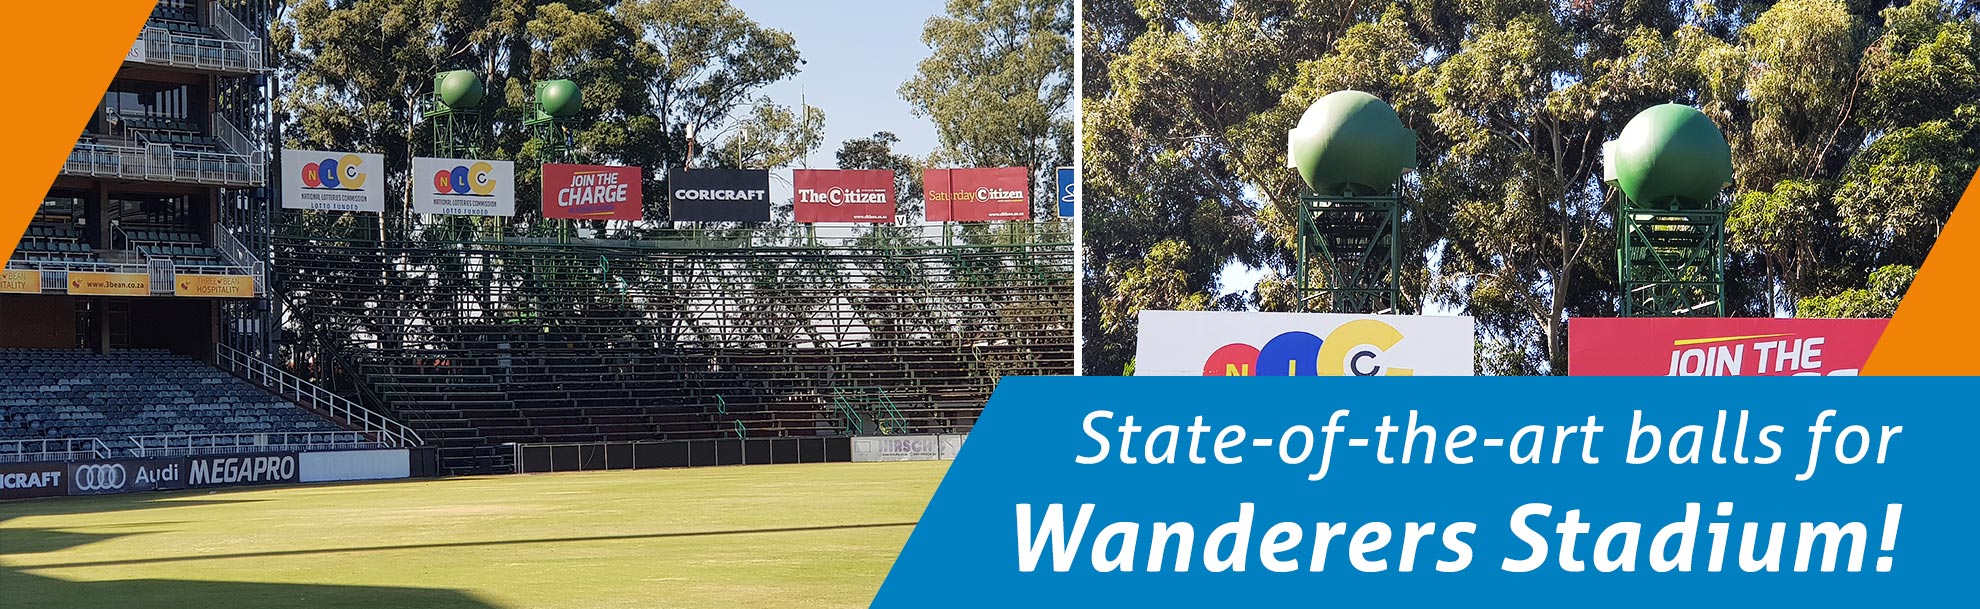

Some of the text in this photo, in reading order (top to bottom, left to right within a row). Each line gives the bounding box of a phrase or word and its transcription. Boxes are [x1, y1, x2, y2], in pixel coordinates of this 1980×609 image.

[570, 172, 619, 187] JOIN THE
[301, 193, 367, 203] NATIONAL LOTTERIES COMMISSION
[557, 184, 628, 207] CHARGE
[674, 189, 765, 201] CORICRAFT
[433, 198, 497, 208] NATIONAL LOTTERIES COMMISSION
[86, 280, 145, 290] www.3bean.co.za
[197, 277, 240, 286] THREE BEAN
[196, 285, 240, 294] HOSPITALITY
[1664, 337, 1825, 376] JOIN THE
[134, 463, 180, 484] Audi
[189, 455, 295, 486] MEGAPRO
